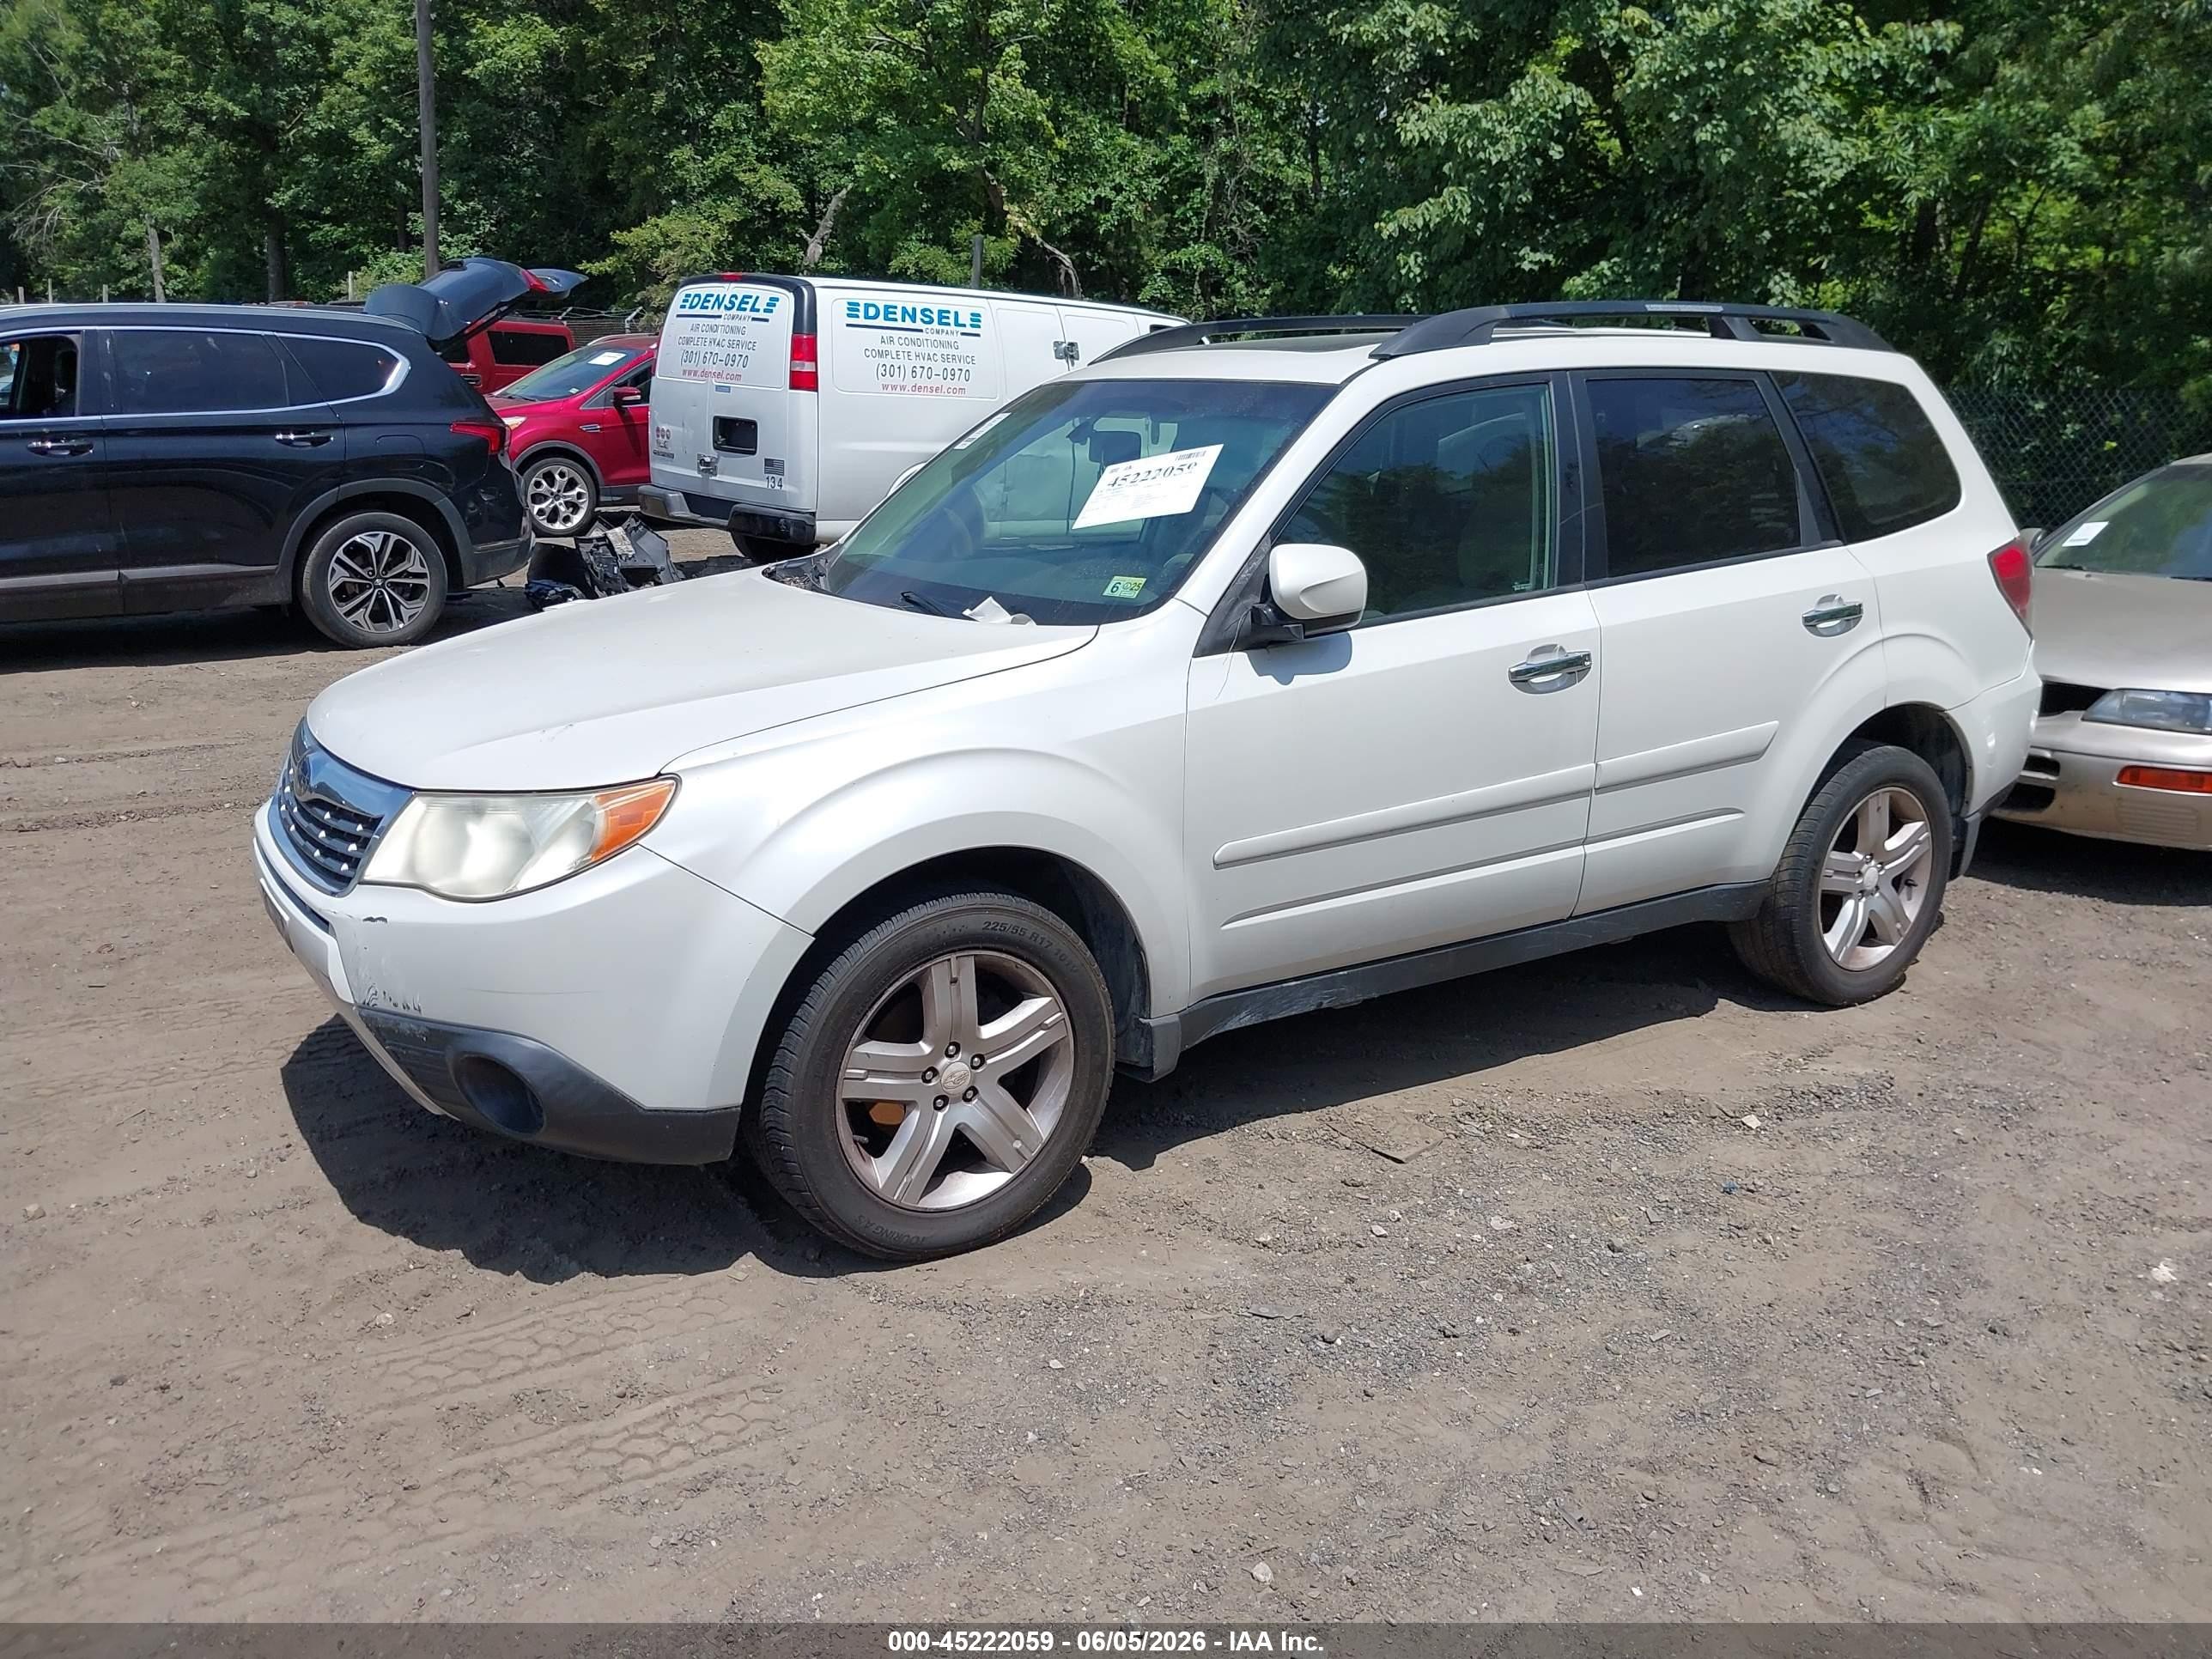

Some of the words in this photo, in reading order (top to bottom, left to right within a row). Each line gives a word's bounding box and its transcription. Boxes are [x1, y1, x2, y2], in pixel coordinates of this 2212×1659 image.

[723, 313, 751, 322] COMPANY
[690, 323, 700, 332] AIR
[701, 324, 747, 336] CONDITIONING
[924, 327, 959, 337] COMPANY
[678, 336, 708, 347] COMPLETE
[708, 337, 726, 349] HVAC
[726, 339, 757, 351] SERVICE
[880, 336, 895, 346] AIR
[897, 337, 959, 349] CONDITIONING
[680, 349, 701, 367] (301)
[702, 351, 749, 368] 670-0970
[864, 348, 913, 361] COMPLETE
[915, 352, 939, 363] HVAC
[940, 354, 976, 366] SERVICE
[682, 368, 742, 381] www.densel.com
[876, 363, 907, 381] (301)
[911, 366, 971, 382] 670-0970
[882, 383, 966, 396] www.densel.com
[765, 476, 783, 490] 134
[1110, 581, 1121, 593] 6
[1129, 582, 1142, 592] 25
[1029, 933, 1054, 949] R17
